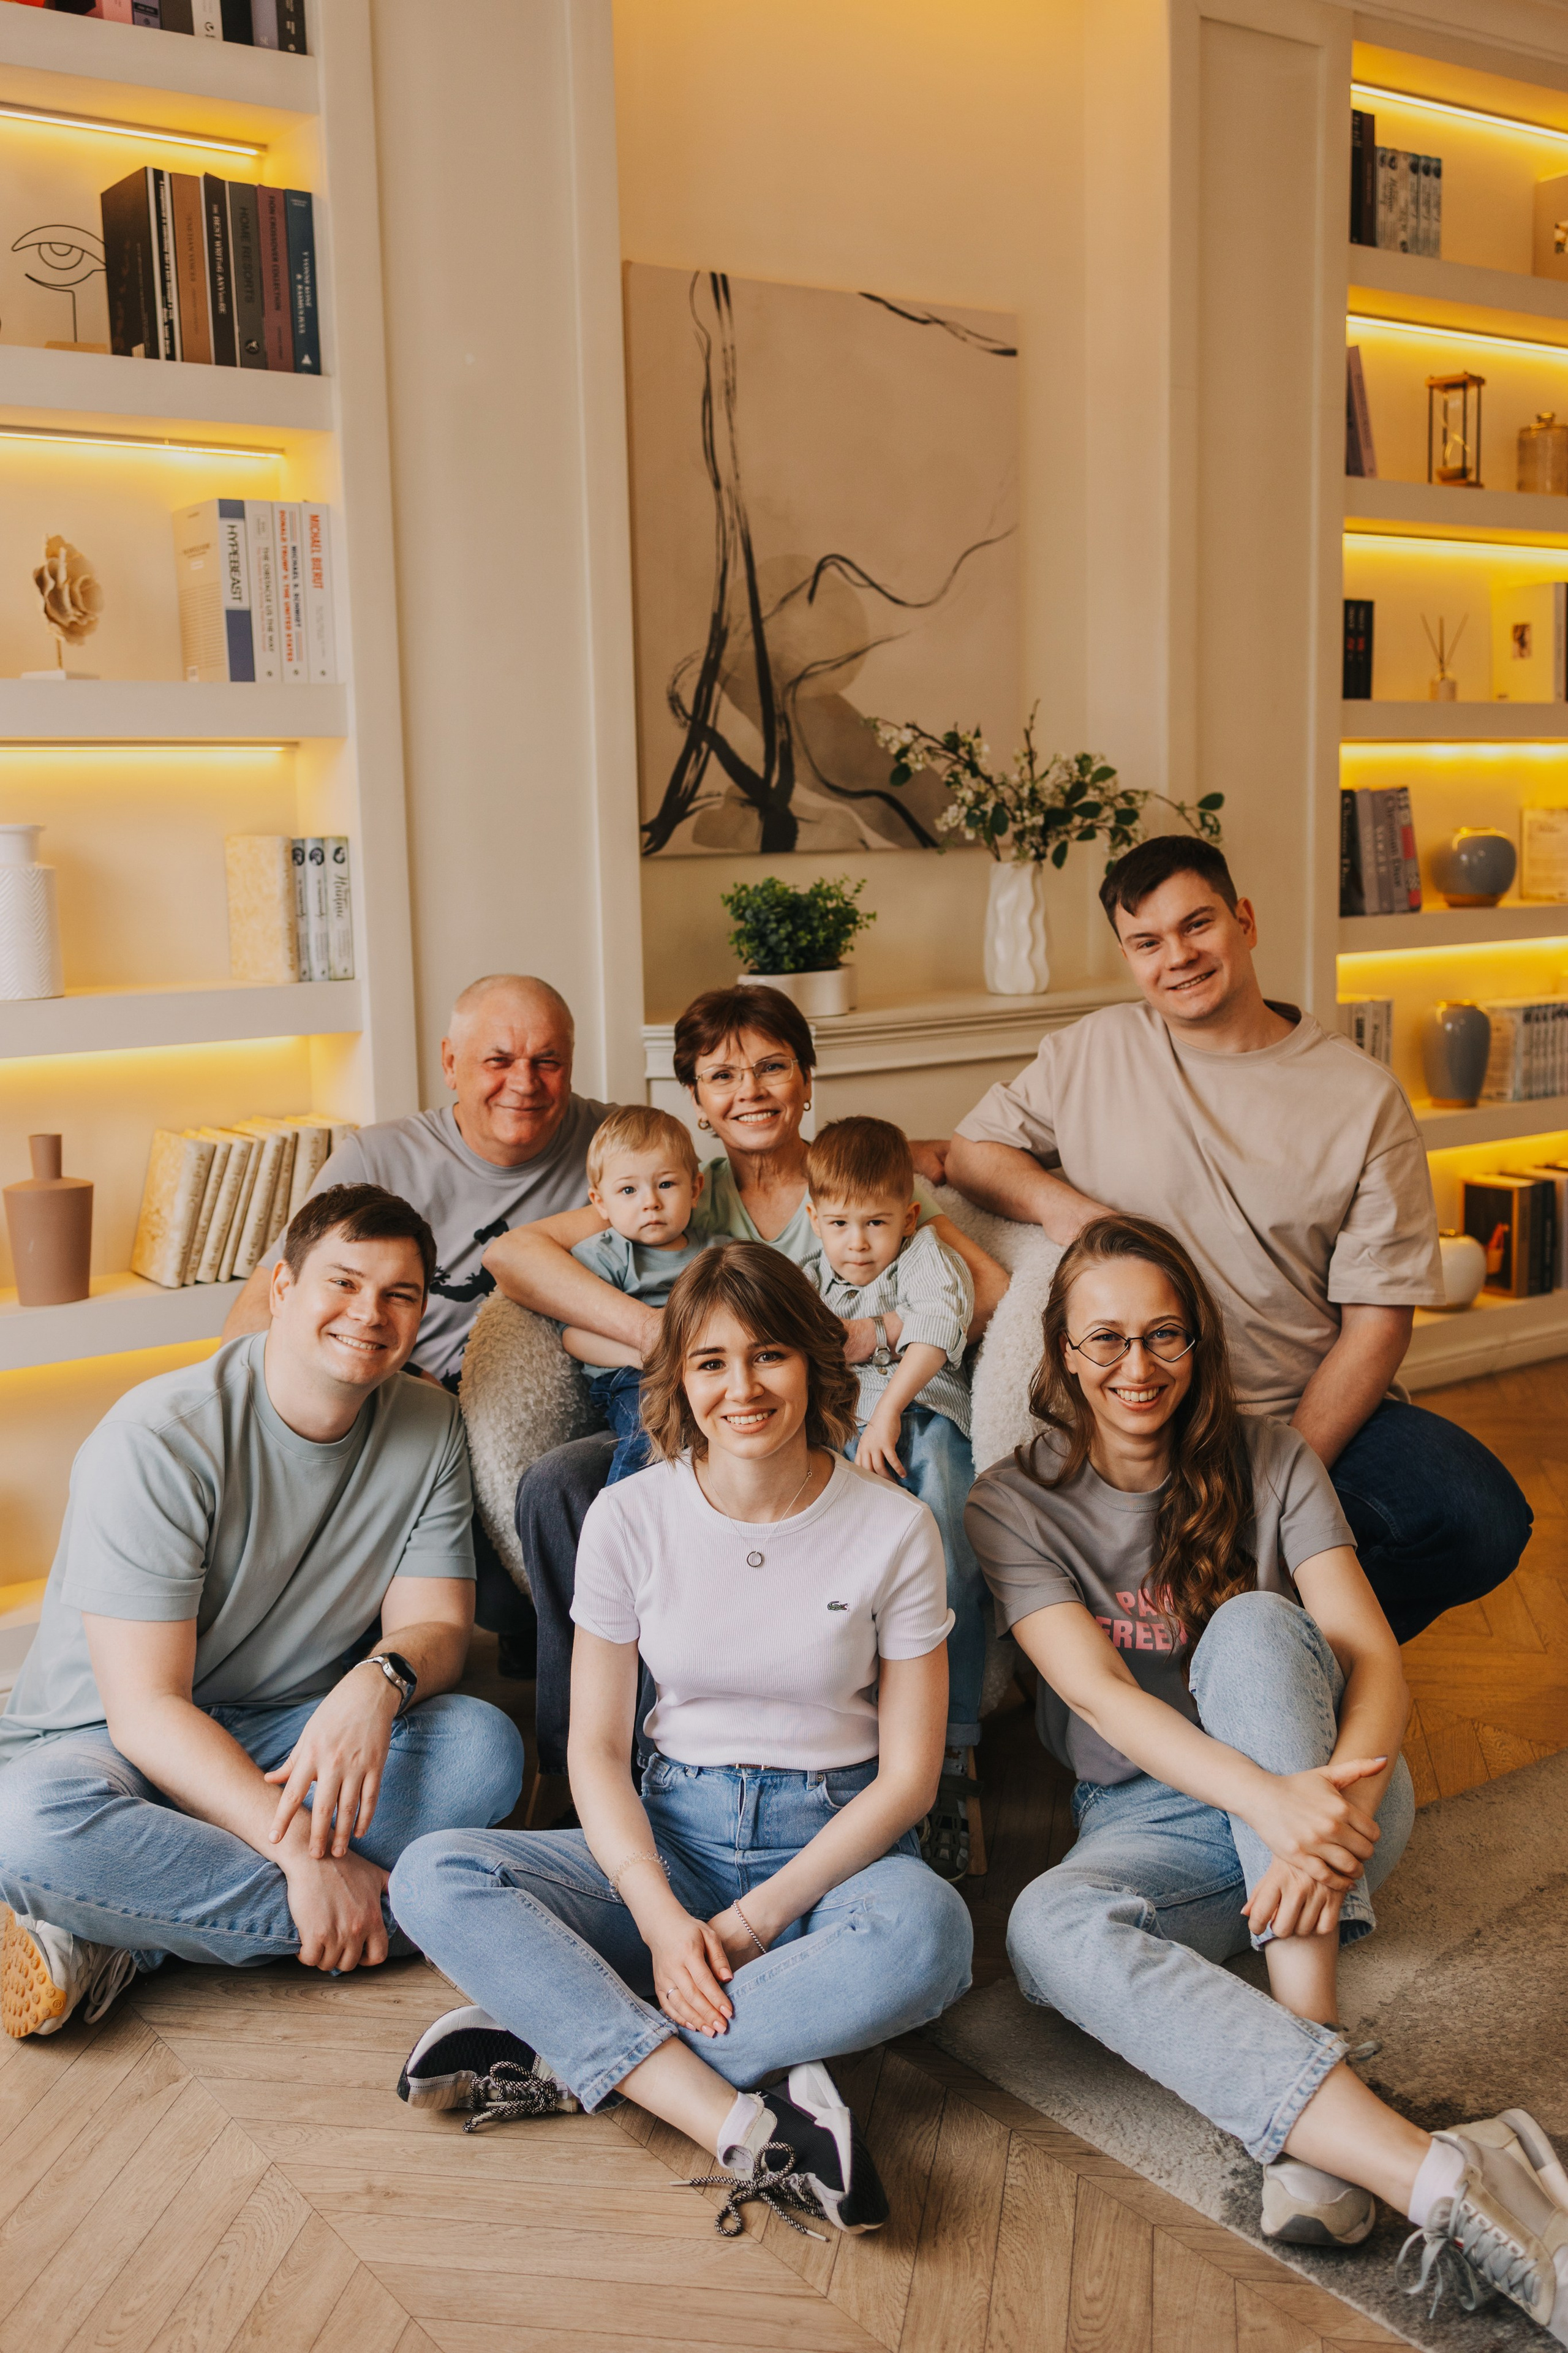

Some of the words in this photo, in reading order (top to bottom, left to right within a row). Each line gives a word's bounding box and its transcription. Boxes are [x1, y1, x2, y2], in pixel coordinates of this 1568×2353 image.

[213, 216, 222, 238] BEST
[239, 206, 251, 242] HOME
[270, 216, 279, 262] CROSSOVER
[272, 263, 281, 311] COLLECTION
[309, 514, 322, 553] MICHAEL
[227, 524, 243, 603] HYPEBEAST
[311, 556, 325, 589] BIERUT
[285, 633, 294, 662] STATES
[1095, 1615, 1172, 1651] FREE
